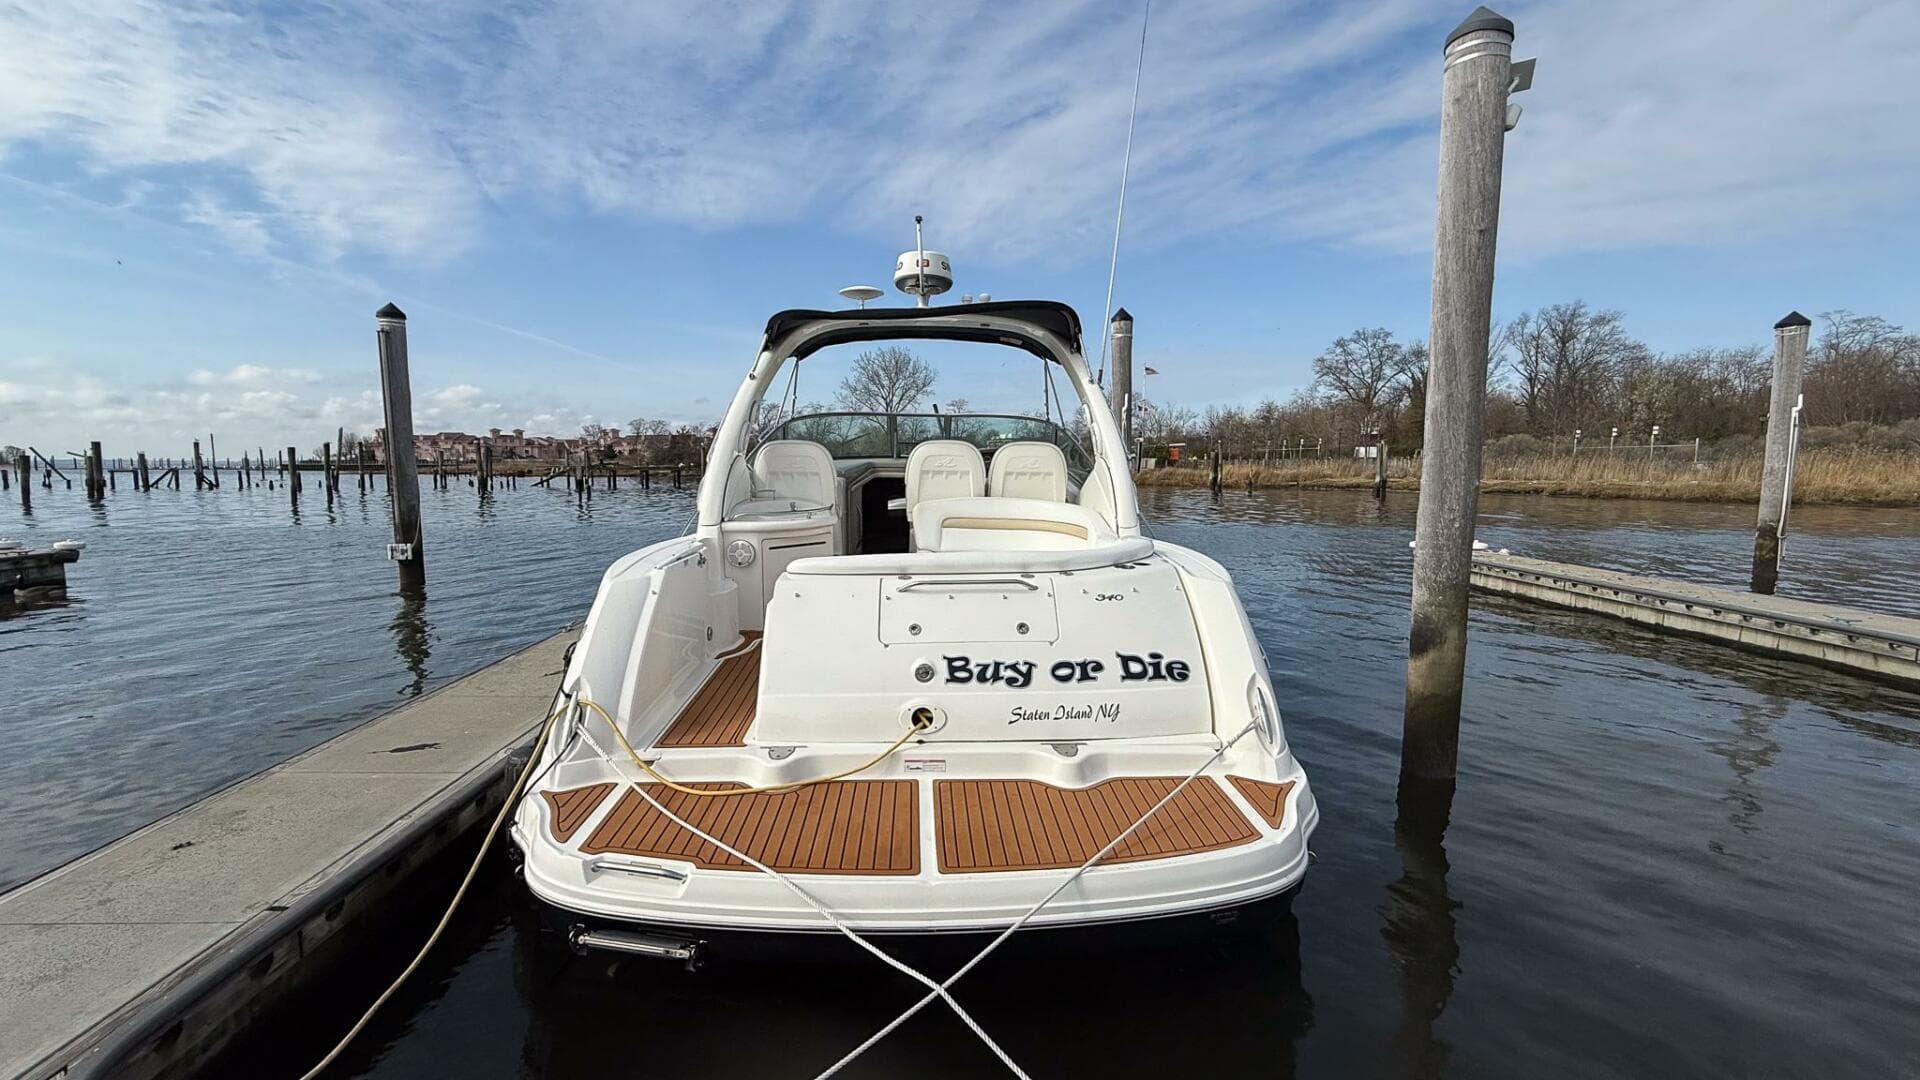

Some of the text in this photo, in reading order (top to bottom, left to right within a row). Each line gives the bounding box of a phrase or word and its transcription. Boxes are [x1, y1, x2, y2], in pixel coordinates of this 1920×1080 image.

[1095, 593, 1124, 602] 340
[943, 651, 1190, 688] Buy or Die
[1008, 703, 1120, 725] Staten Island NY
